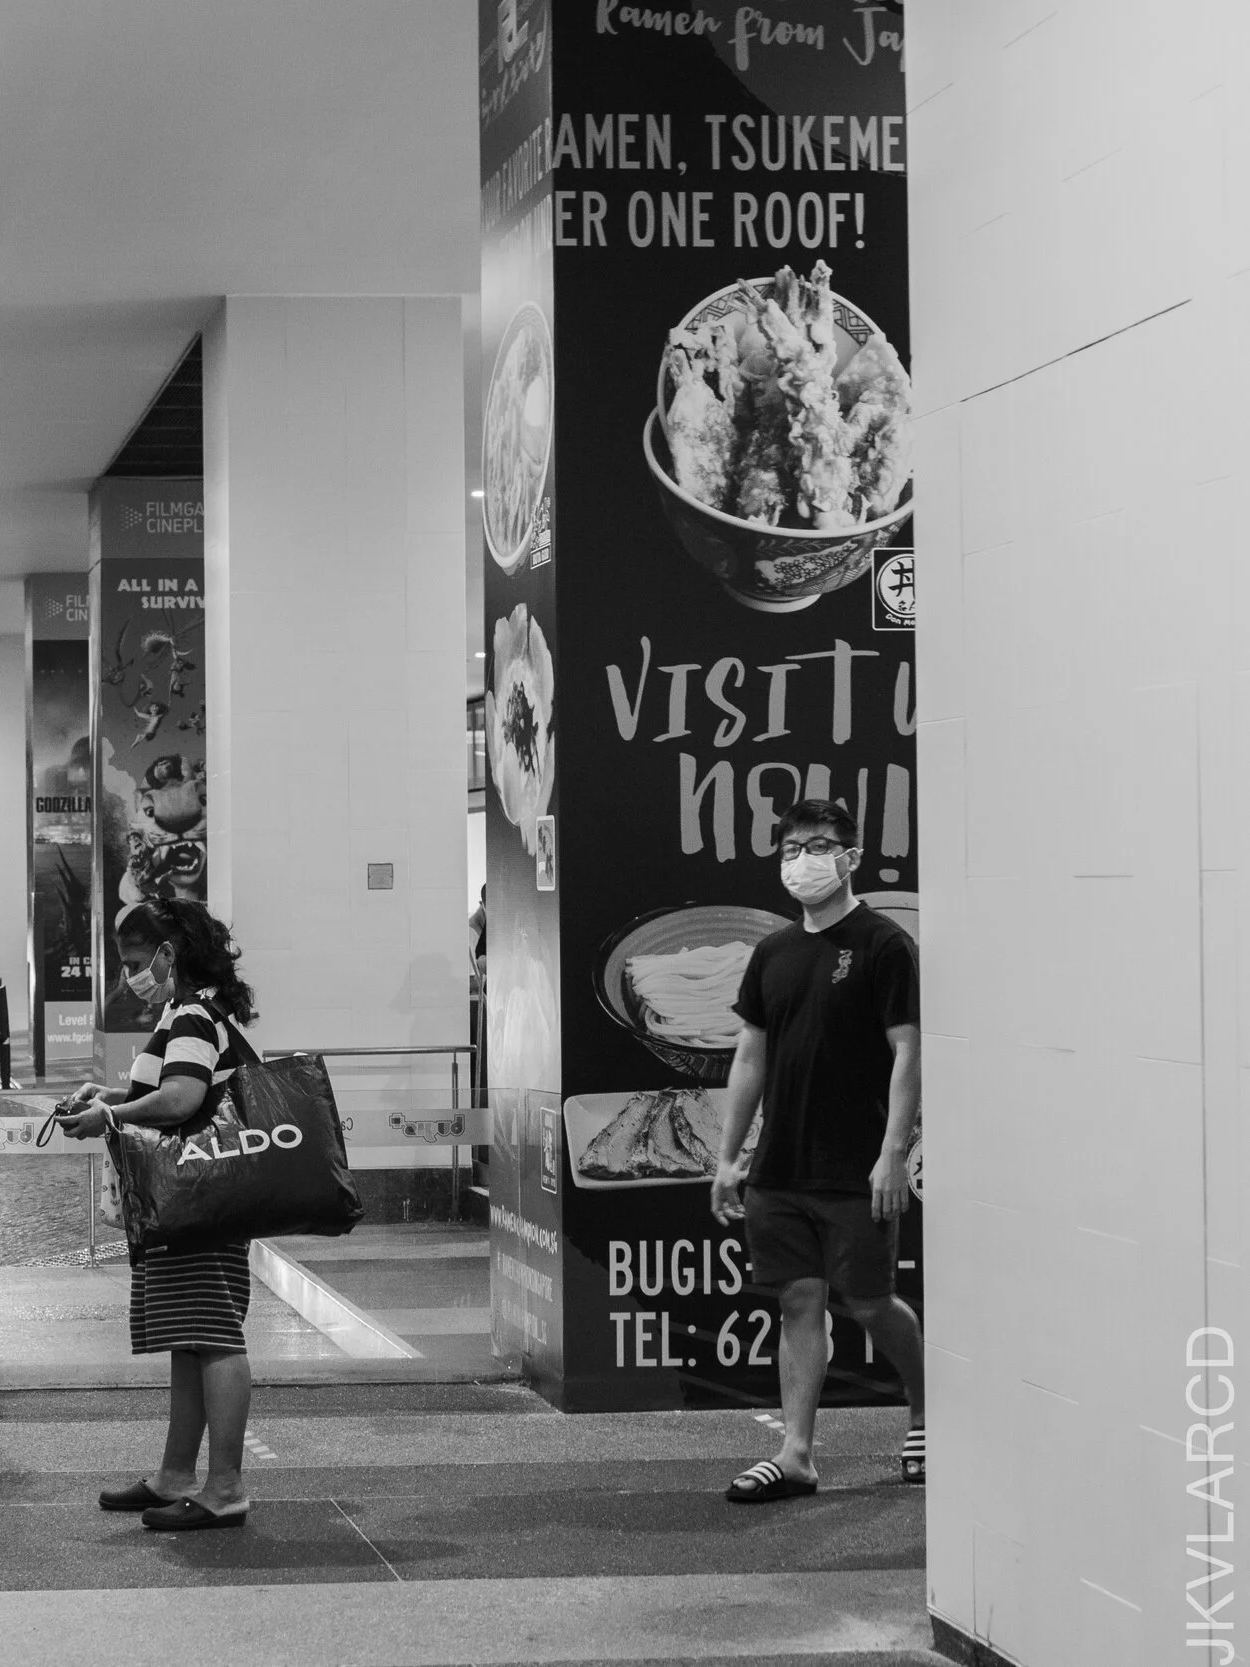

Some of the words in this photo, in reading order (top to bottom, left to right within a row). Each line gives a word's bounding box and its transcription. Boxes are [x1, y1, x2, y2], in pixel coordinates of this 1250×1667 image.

[596, 0, 721, 36] Ramen
[727, 7, 825, 71] from
[843, 7, 905, 73] Ja
[629, 191, 715, 248] ONE
[734, 191, 866, 249] ROOF!
[117, 578, 151, 592] ALL
[158, 578, 178, 592] IN
[184, 578, 198, 592] A
[606, 636, 880, 747] VISIT
[36, 796, 91, 813] GODZILLA
[61, 966, 81, 978] 24
[59, 1014, 87, 1026] Level
[177, 1124, 303, 1166] ALDO
[609, 1238, 753, 1297] BUGIS
[609, 1311, 697, 1368] TEL:
